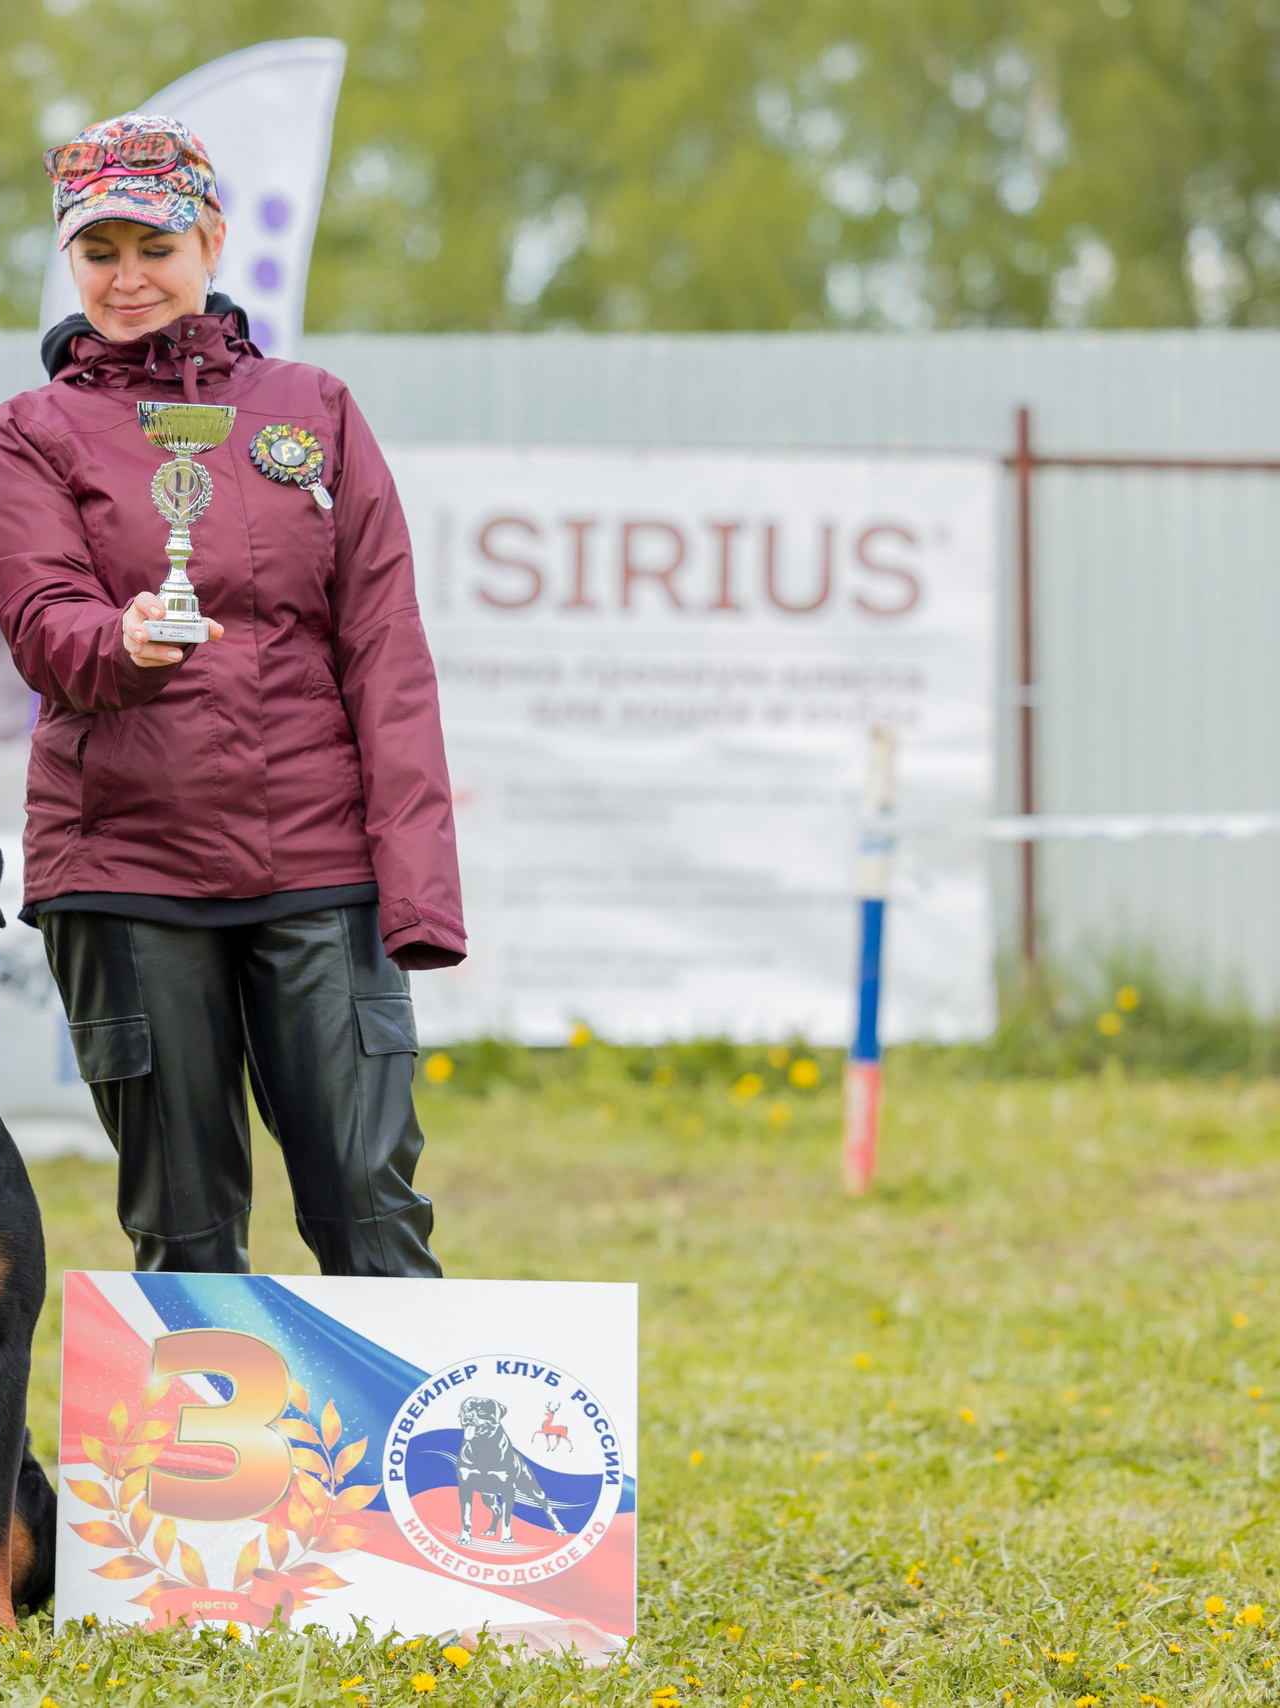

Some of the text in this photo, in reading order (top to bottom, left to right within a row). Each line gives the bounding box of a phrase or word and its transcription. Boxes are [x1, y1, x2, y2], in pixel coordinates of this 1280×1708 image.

[470, 510, 926, 622] SIRIUS
[146, 1328, 293, 1523] 3
[389, 1360, 620, 1486] РОТВЕЙЛЕР КЛУБ РОССИИ
[192, 1600, 238, 1610] место
[403, 1517, 606, 1585] НИЖЕГОРОДСКОЕ РО
